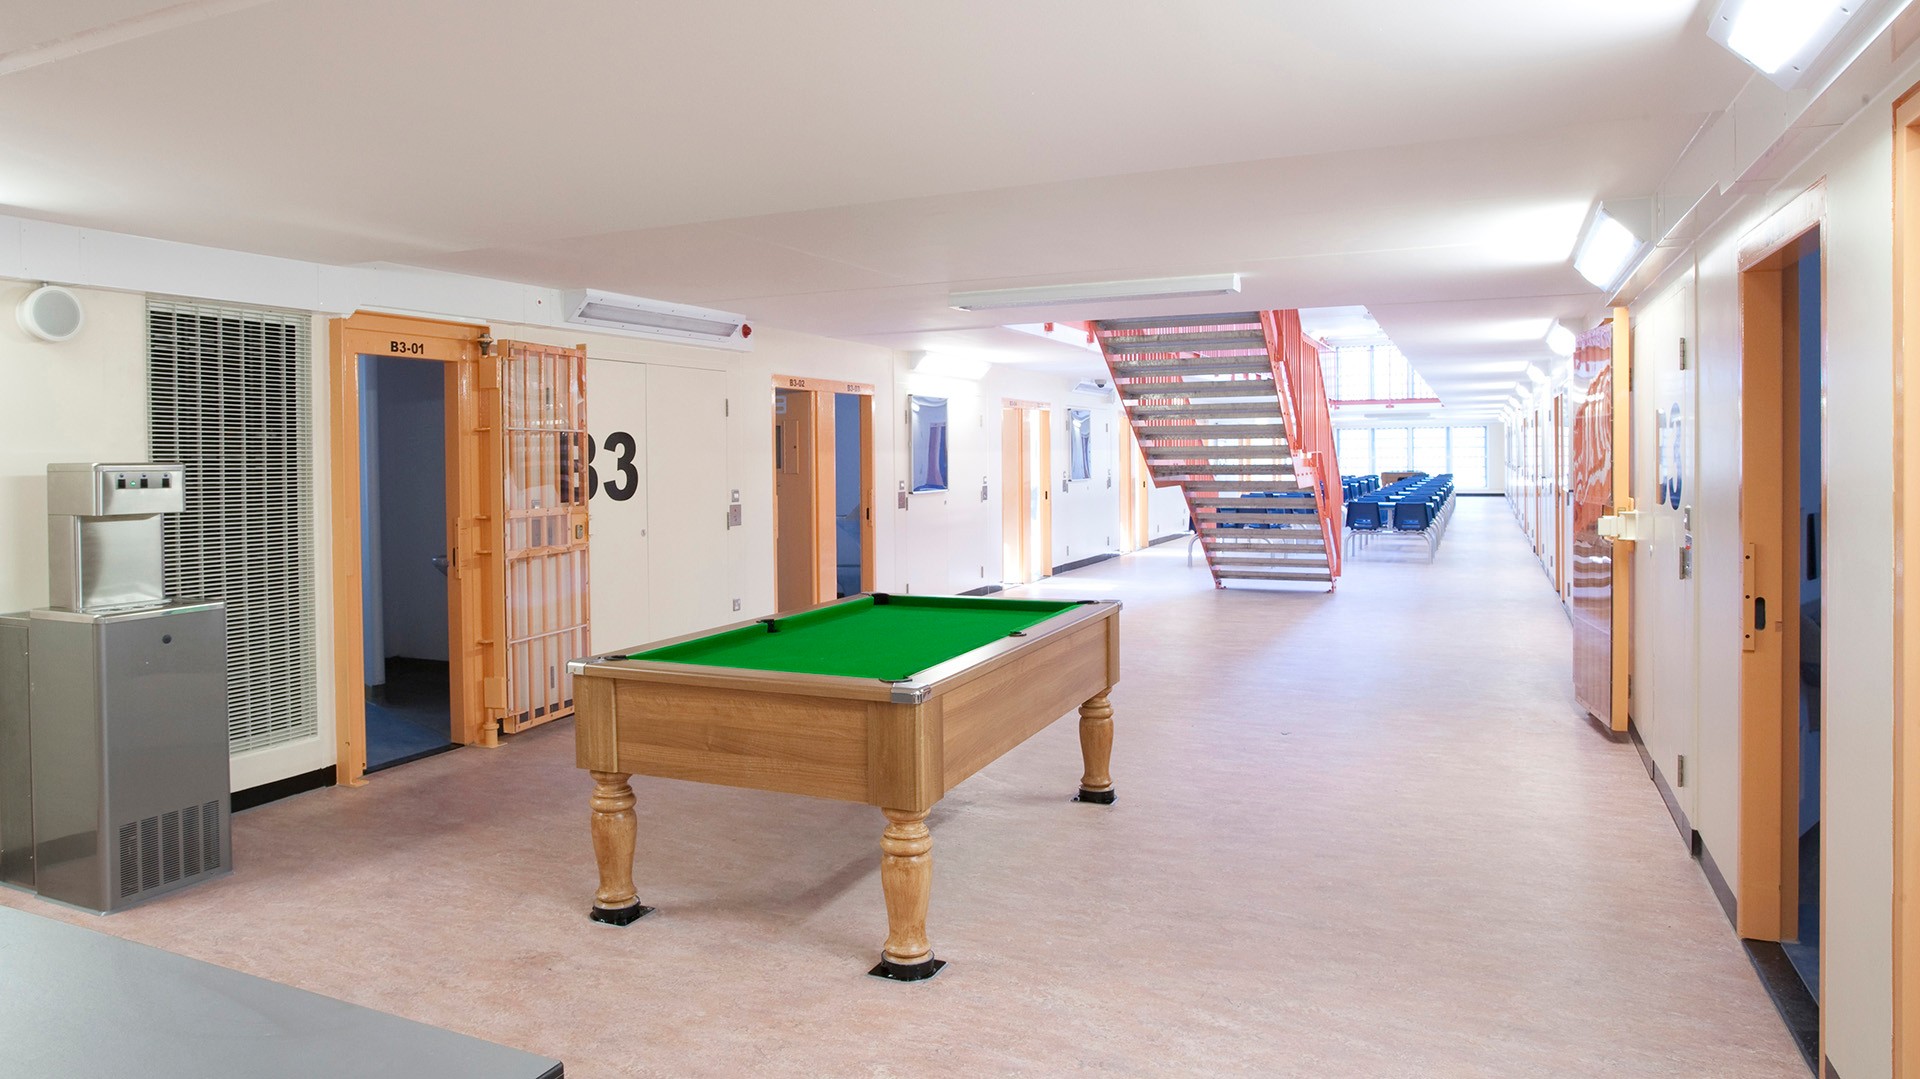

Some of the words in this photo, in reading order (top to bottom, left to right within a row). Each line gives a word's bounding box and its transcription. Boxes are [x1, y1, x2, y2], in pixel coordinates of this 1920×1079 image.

[390, 341, 424, 355] B3-01
[789, 379, 805, 387] B3-02
[560, 431, 638, 502] B3
